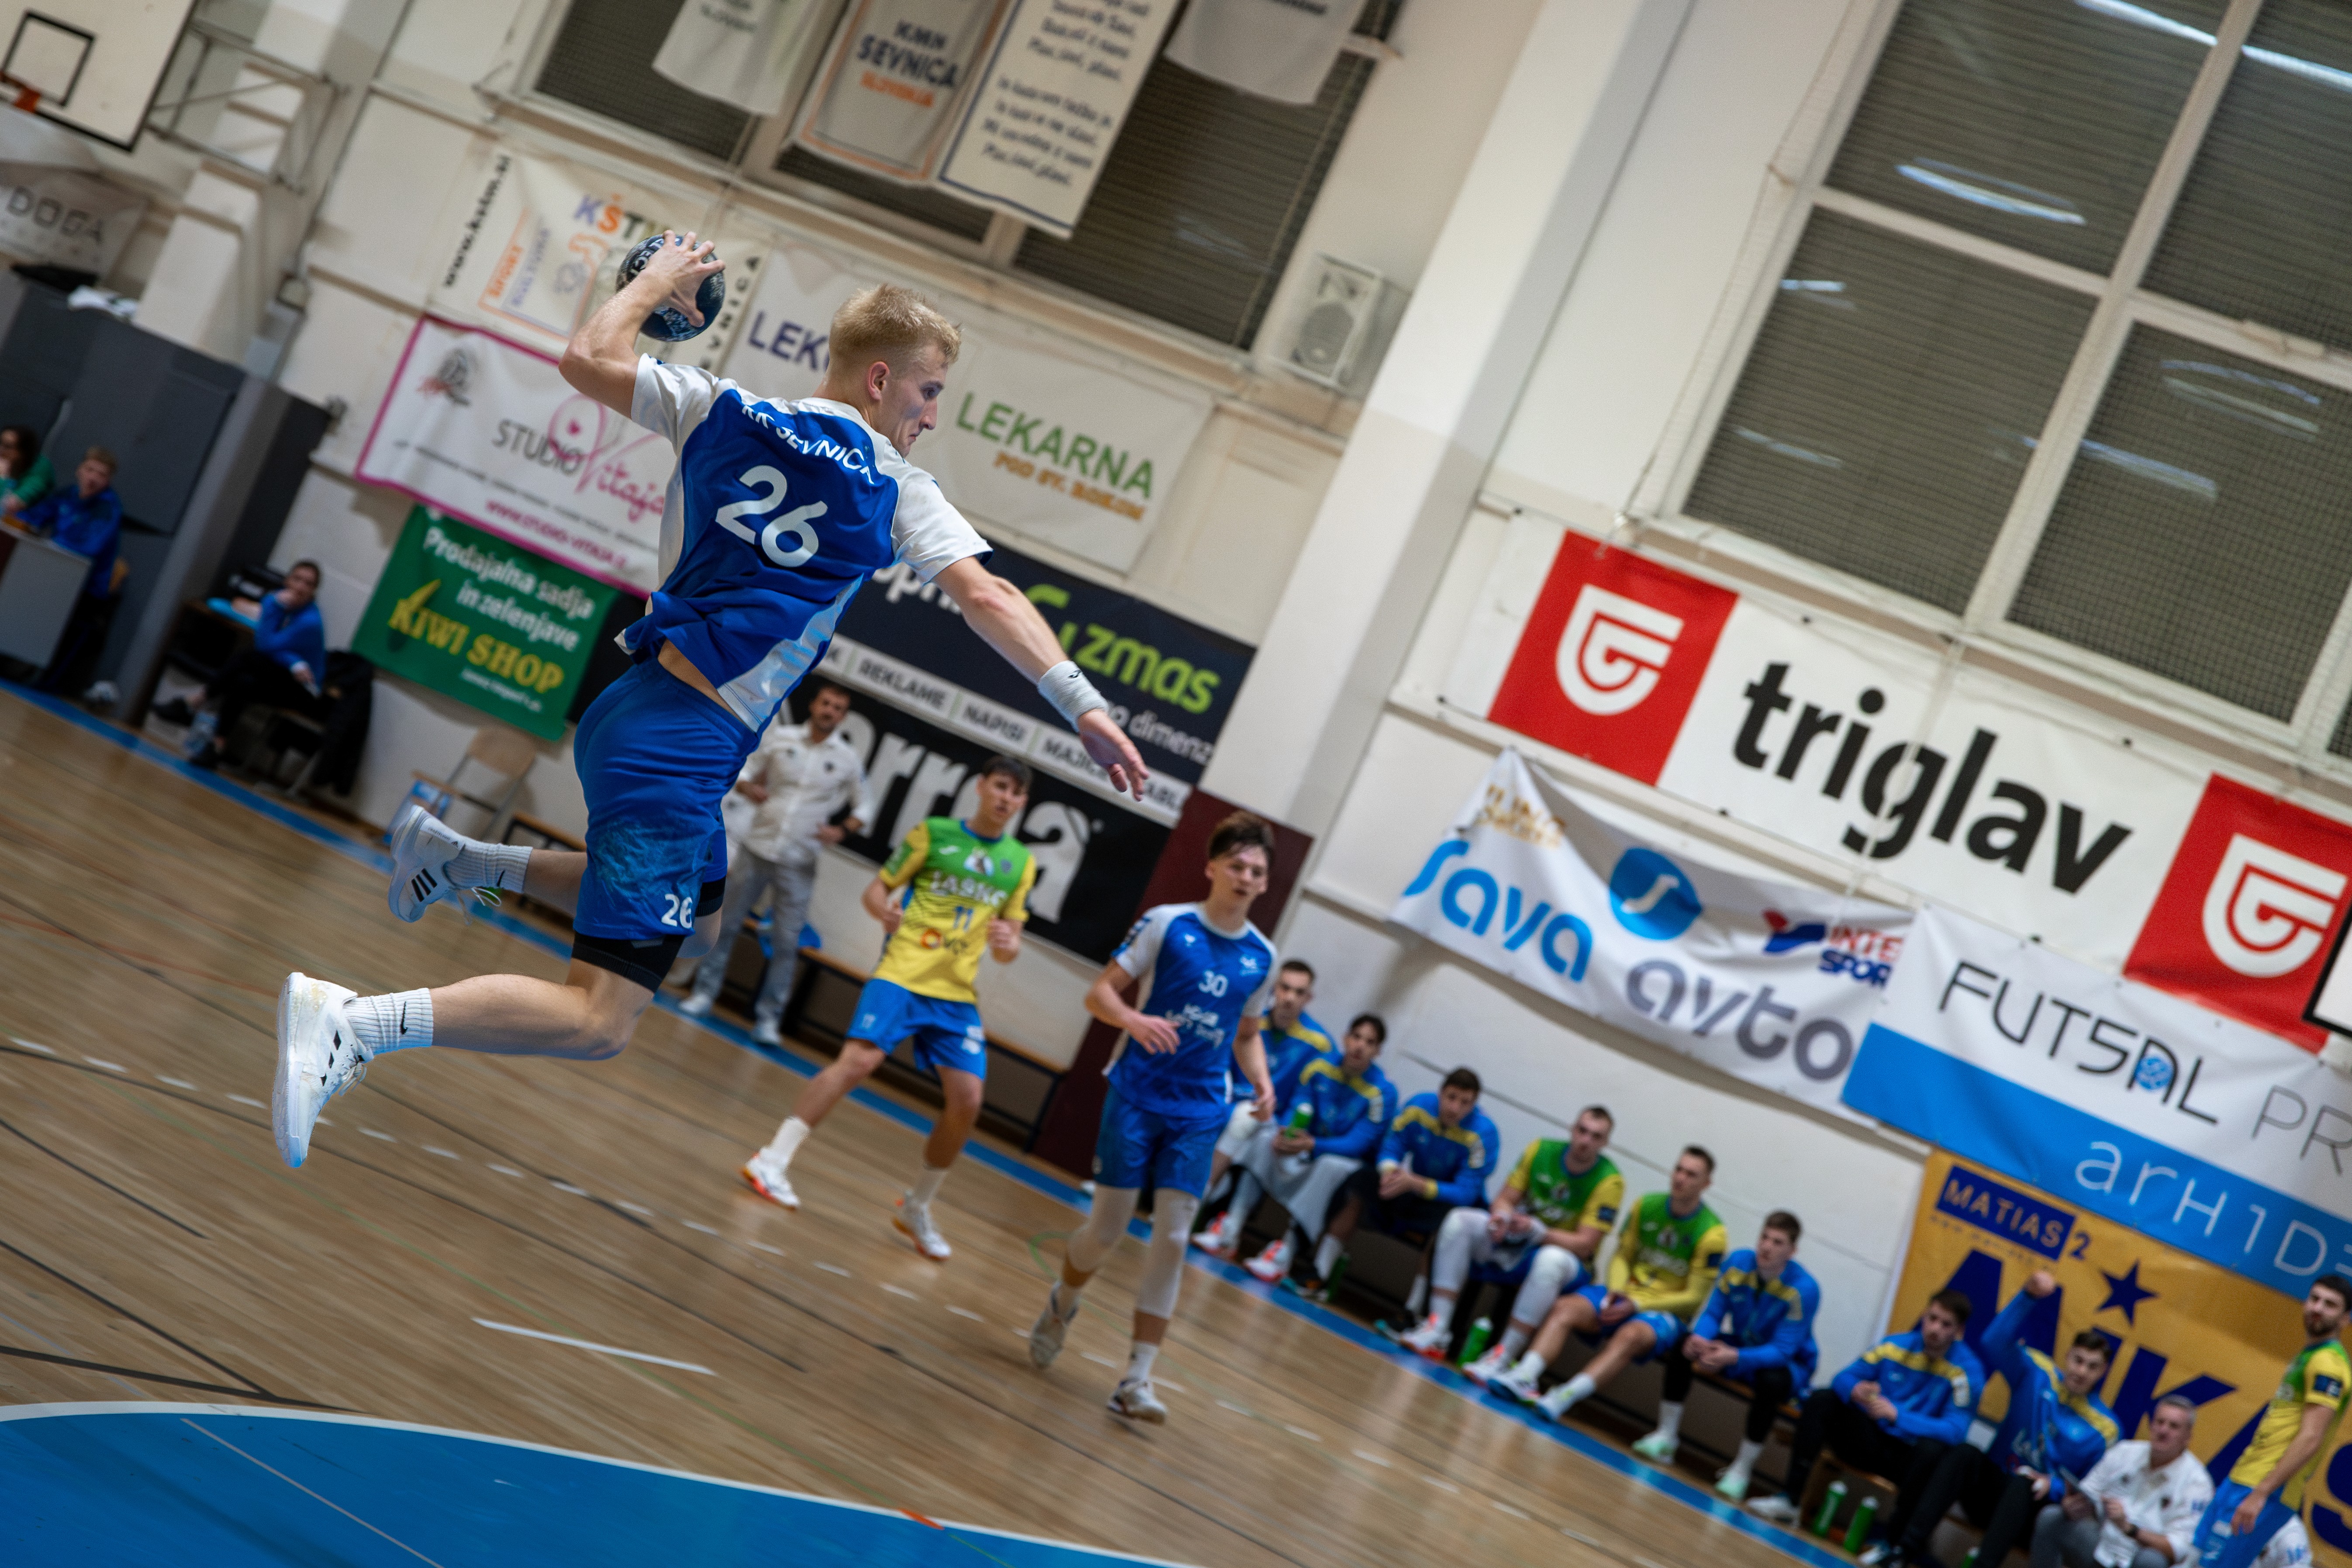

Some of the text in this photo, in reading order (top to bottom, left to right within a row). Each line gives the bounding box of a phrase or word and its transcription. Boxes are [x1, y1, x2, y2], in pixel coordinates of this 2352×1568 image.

[858, 34, 958, 88] SEVNICA
[699, 256, 760, 371] EVNICA
[492, 418, 586, 477] STUDIO
[957, 393, 1154, 501] LEKARNA
[715, 465, 828, 567] 26
[423, 526, 595, 620] Prodajalna sadja
[457, 581, 580, 653] in zelenjave
[389, 597, 470, 656] KIWI
[466, 632, 565, 694] SHOP
[859, 656, 948, 709] REKLAME
[1732, 661, 2136, 897] triglav
[660, 894, 694, 929] 26
[1199, 970, 1228, 998] 30
[1627, 959, 1853, 1082] avto
[1937, 960, 2218, 1126] FUTSAL
[1943, 1178, 2063, 1250] MATIAS
[2069, 1231, 2093, 1262] 2
